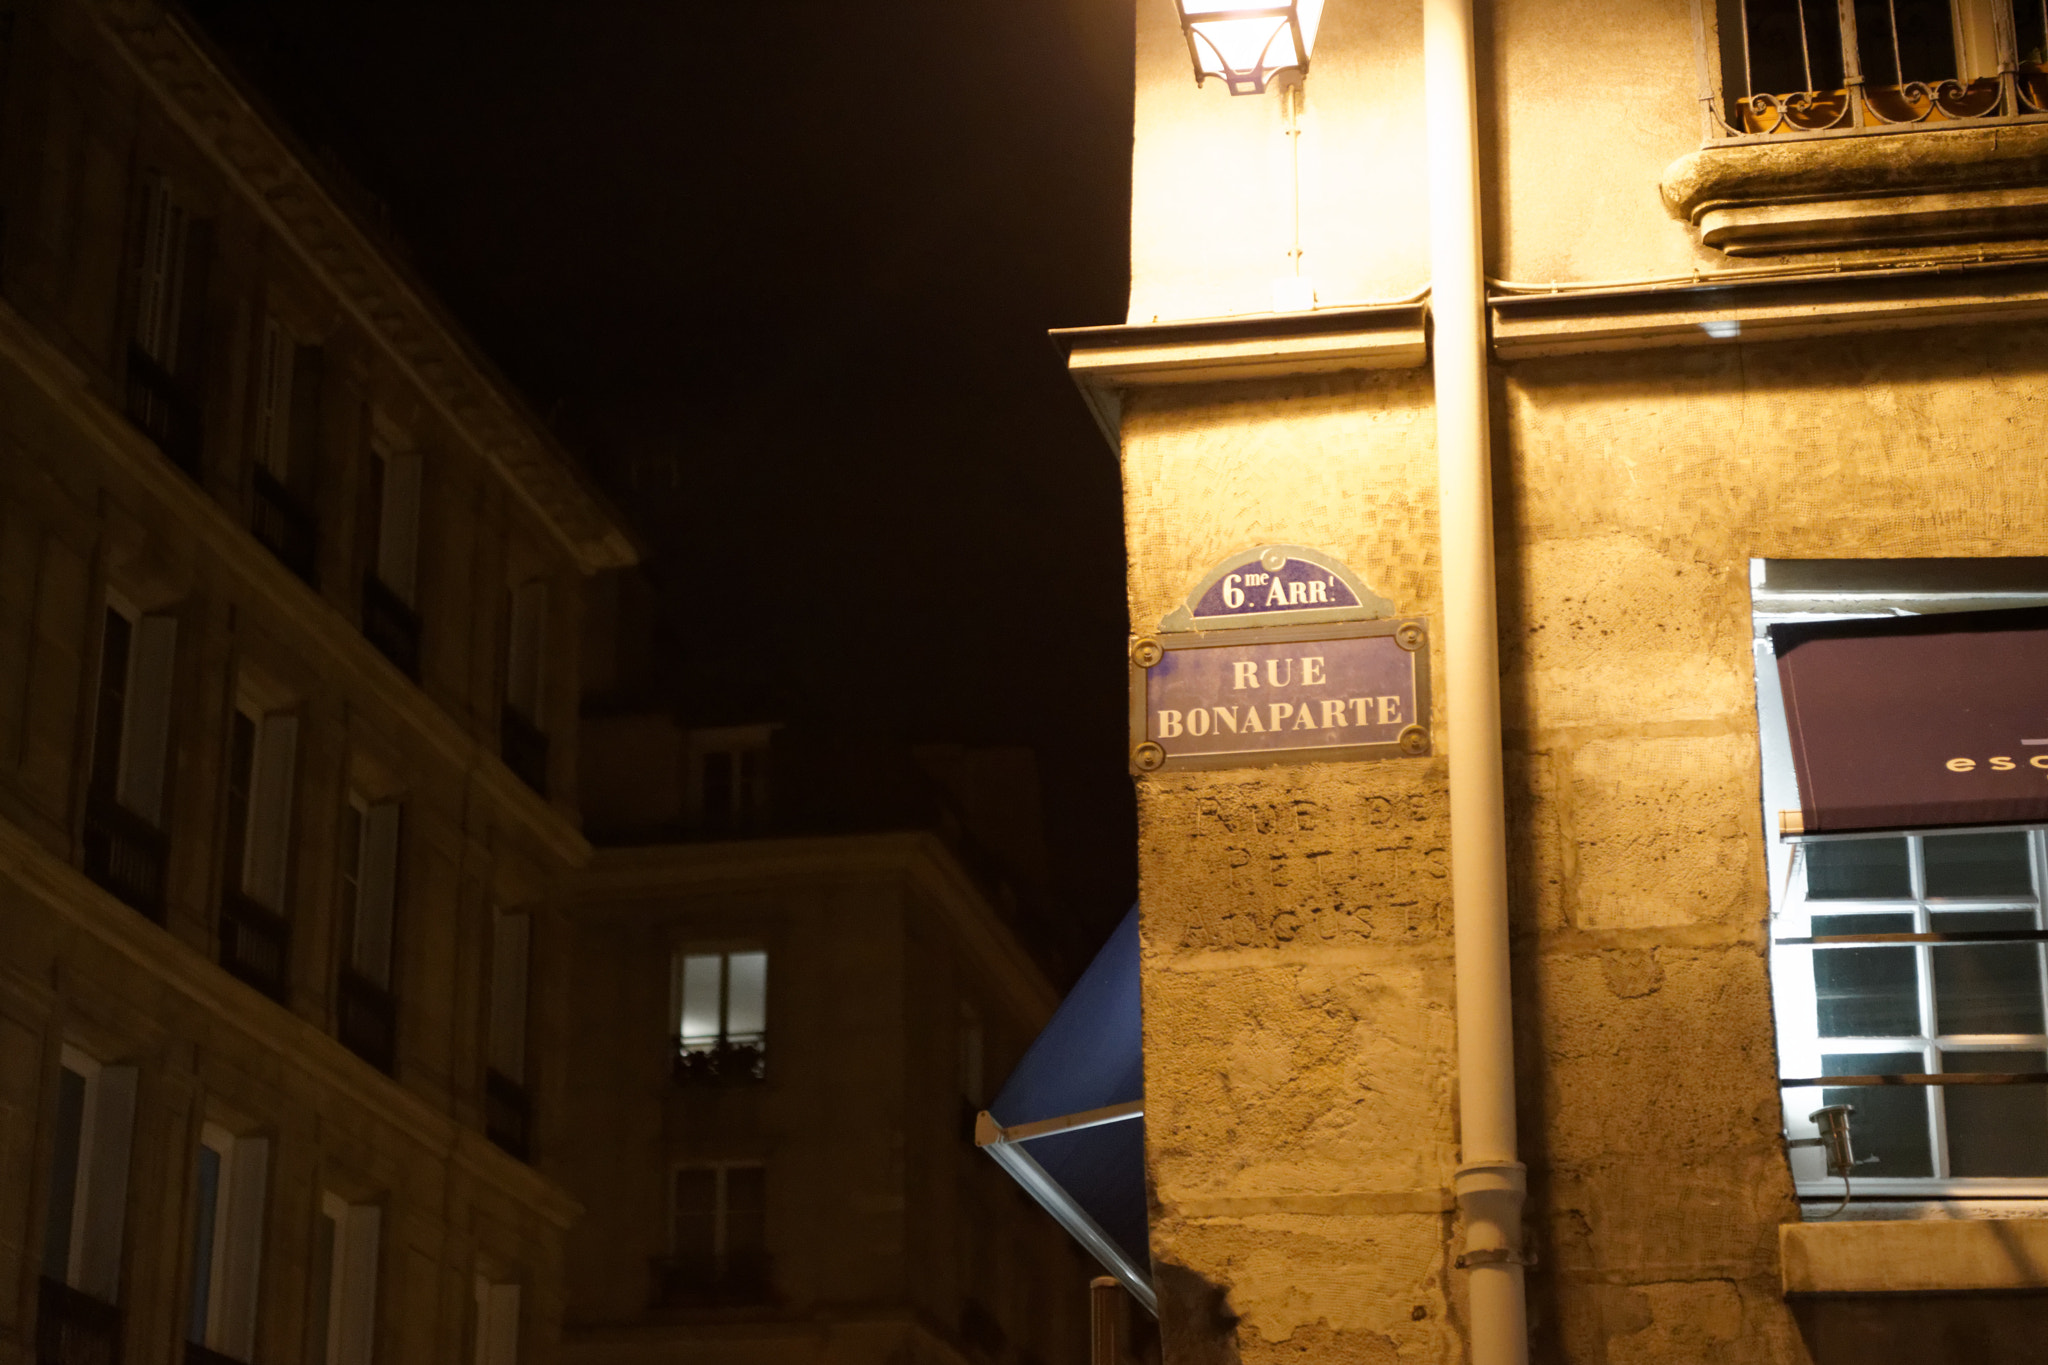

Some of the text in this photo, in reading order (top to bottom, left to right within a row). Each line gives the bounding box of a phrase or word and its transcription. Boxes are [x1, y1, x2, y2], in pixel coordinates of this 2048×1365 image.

[1232, 656, 1327, 690] RUE
[1157, 695, 1403, 738] BONAPARTE
[1191, 797, 1316, 837] RUE
